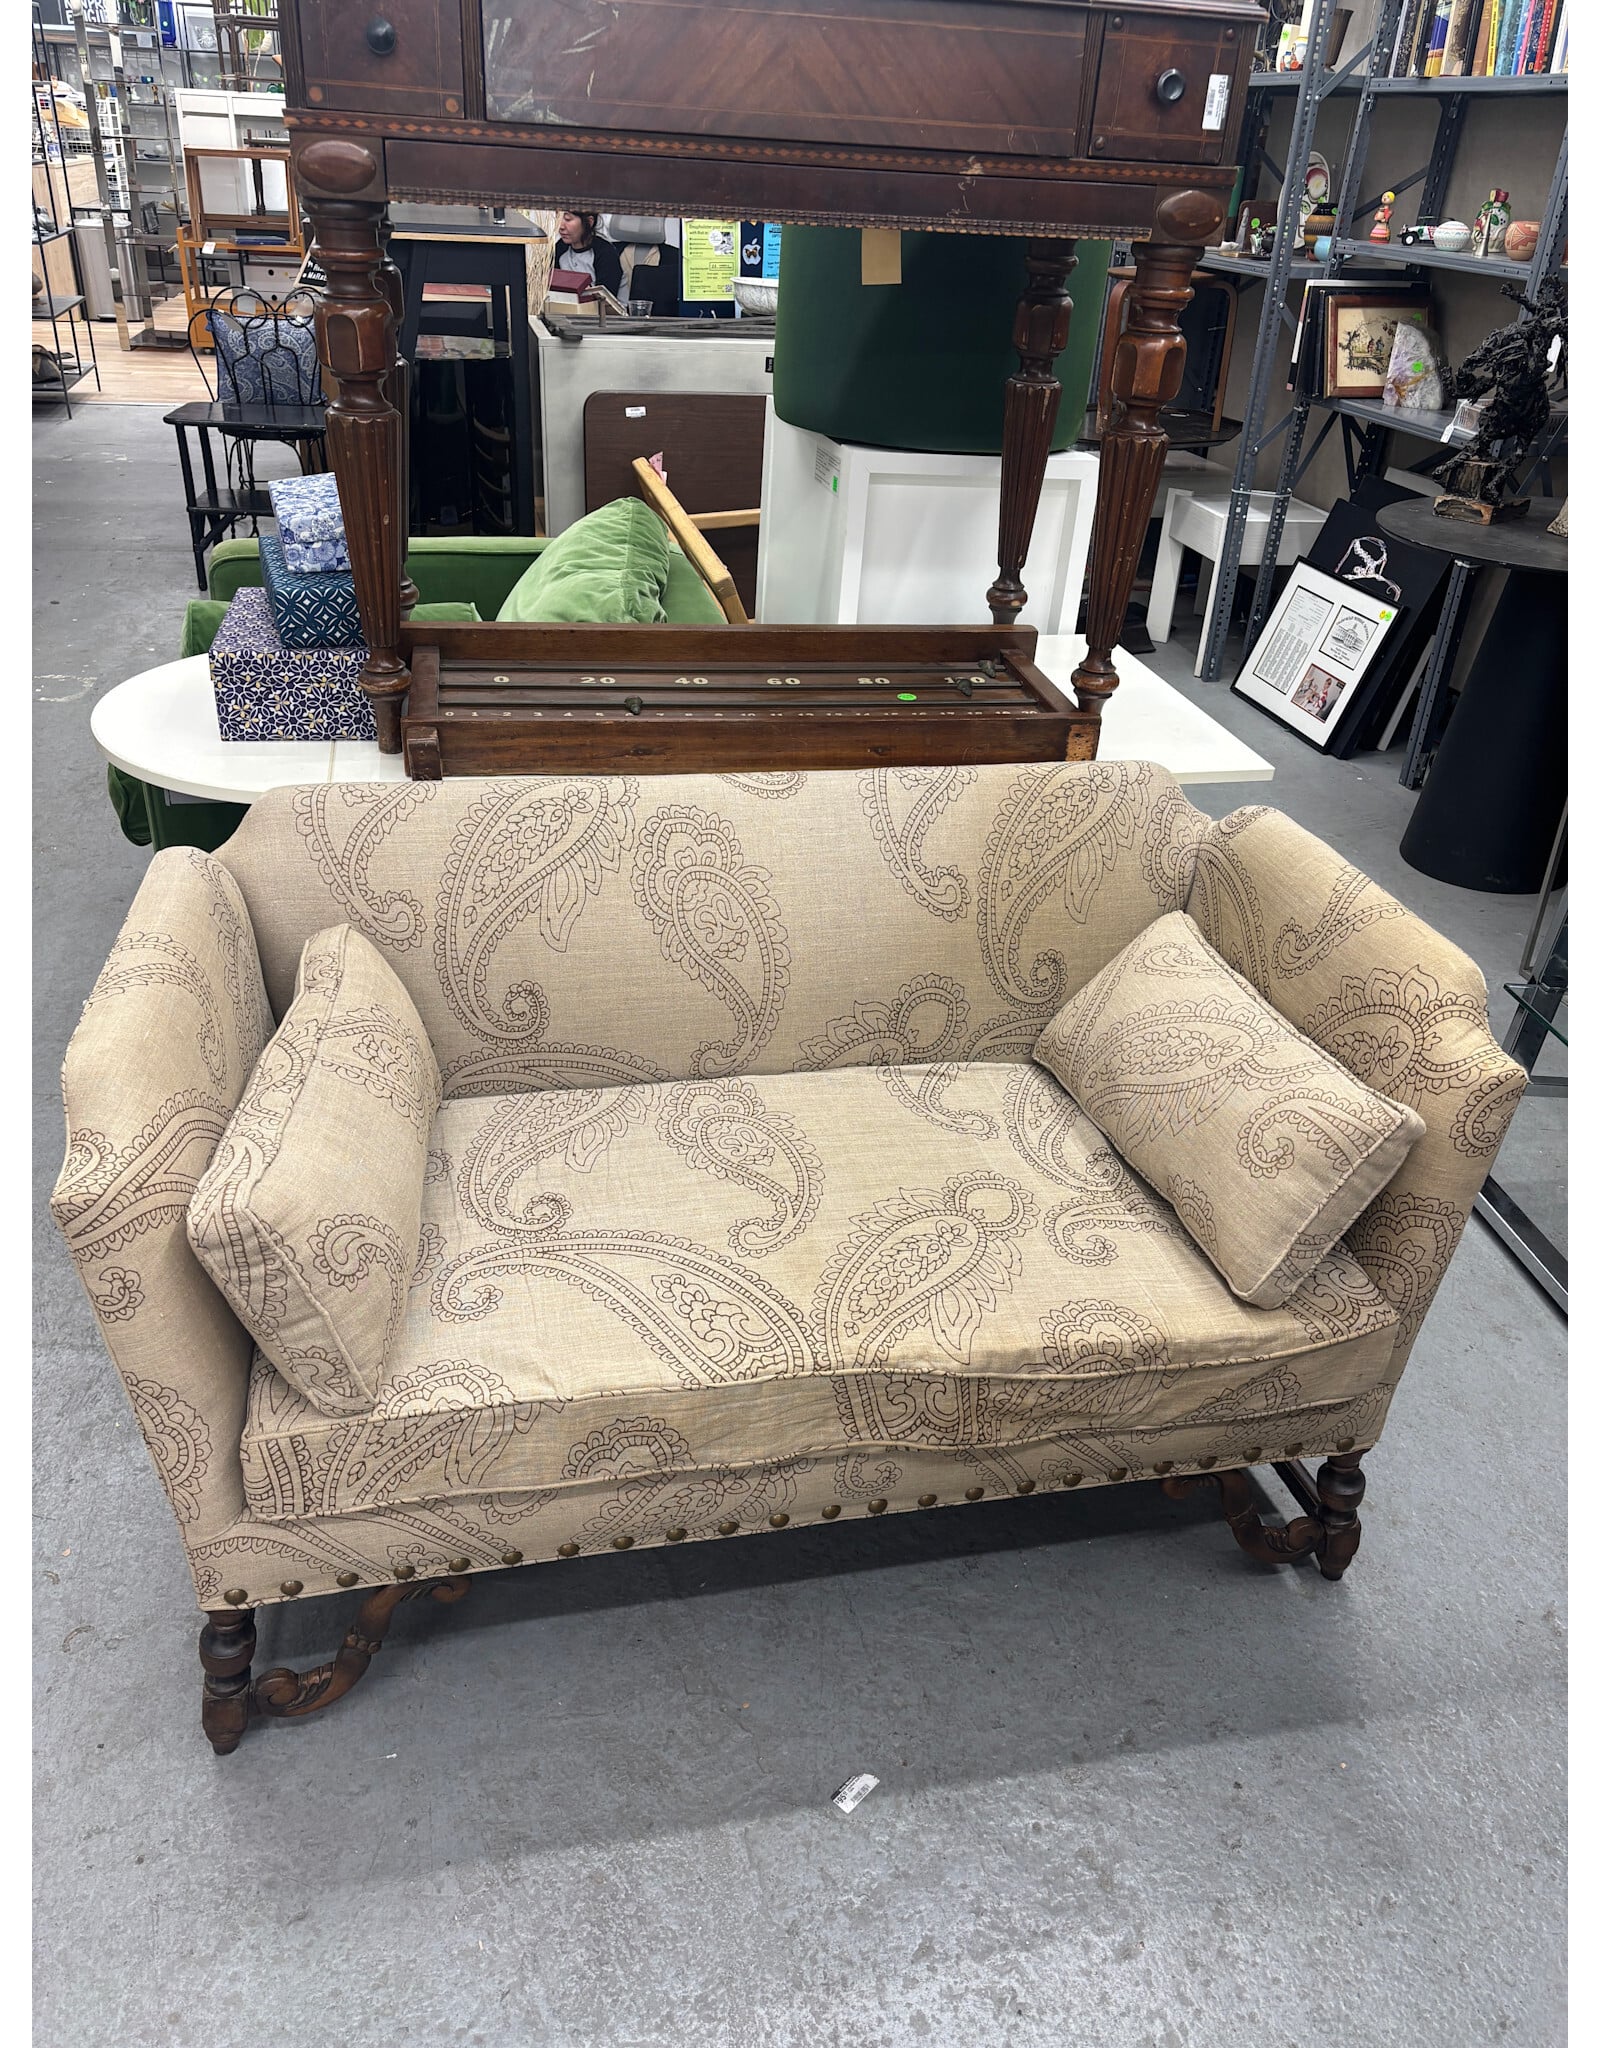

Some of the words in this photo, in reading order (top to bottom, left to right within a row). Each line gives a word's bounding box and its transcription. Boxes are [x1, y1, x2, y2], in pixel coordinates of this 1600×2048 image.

[493, 675, 510, 683] 0
[580, 676, 616, 684] 20
[674, 677, 709, 685] 40
[766, 677, 801, 685] 60
[857, 677, 890, 685] 80
